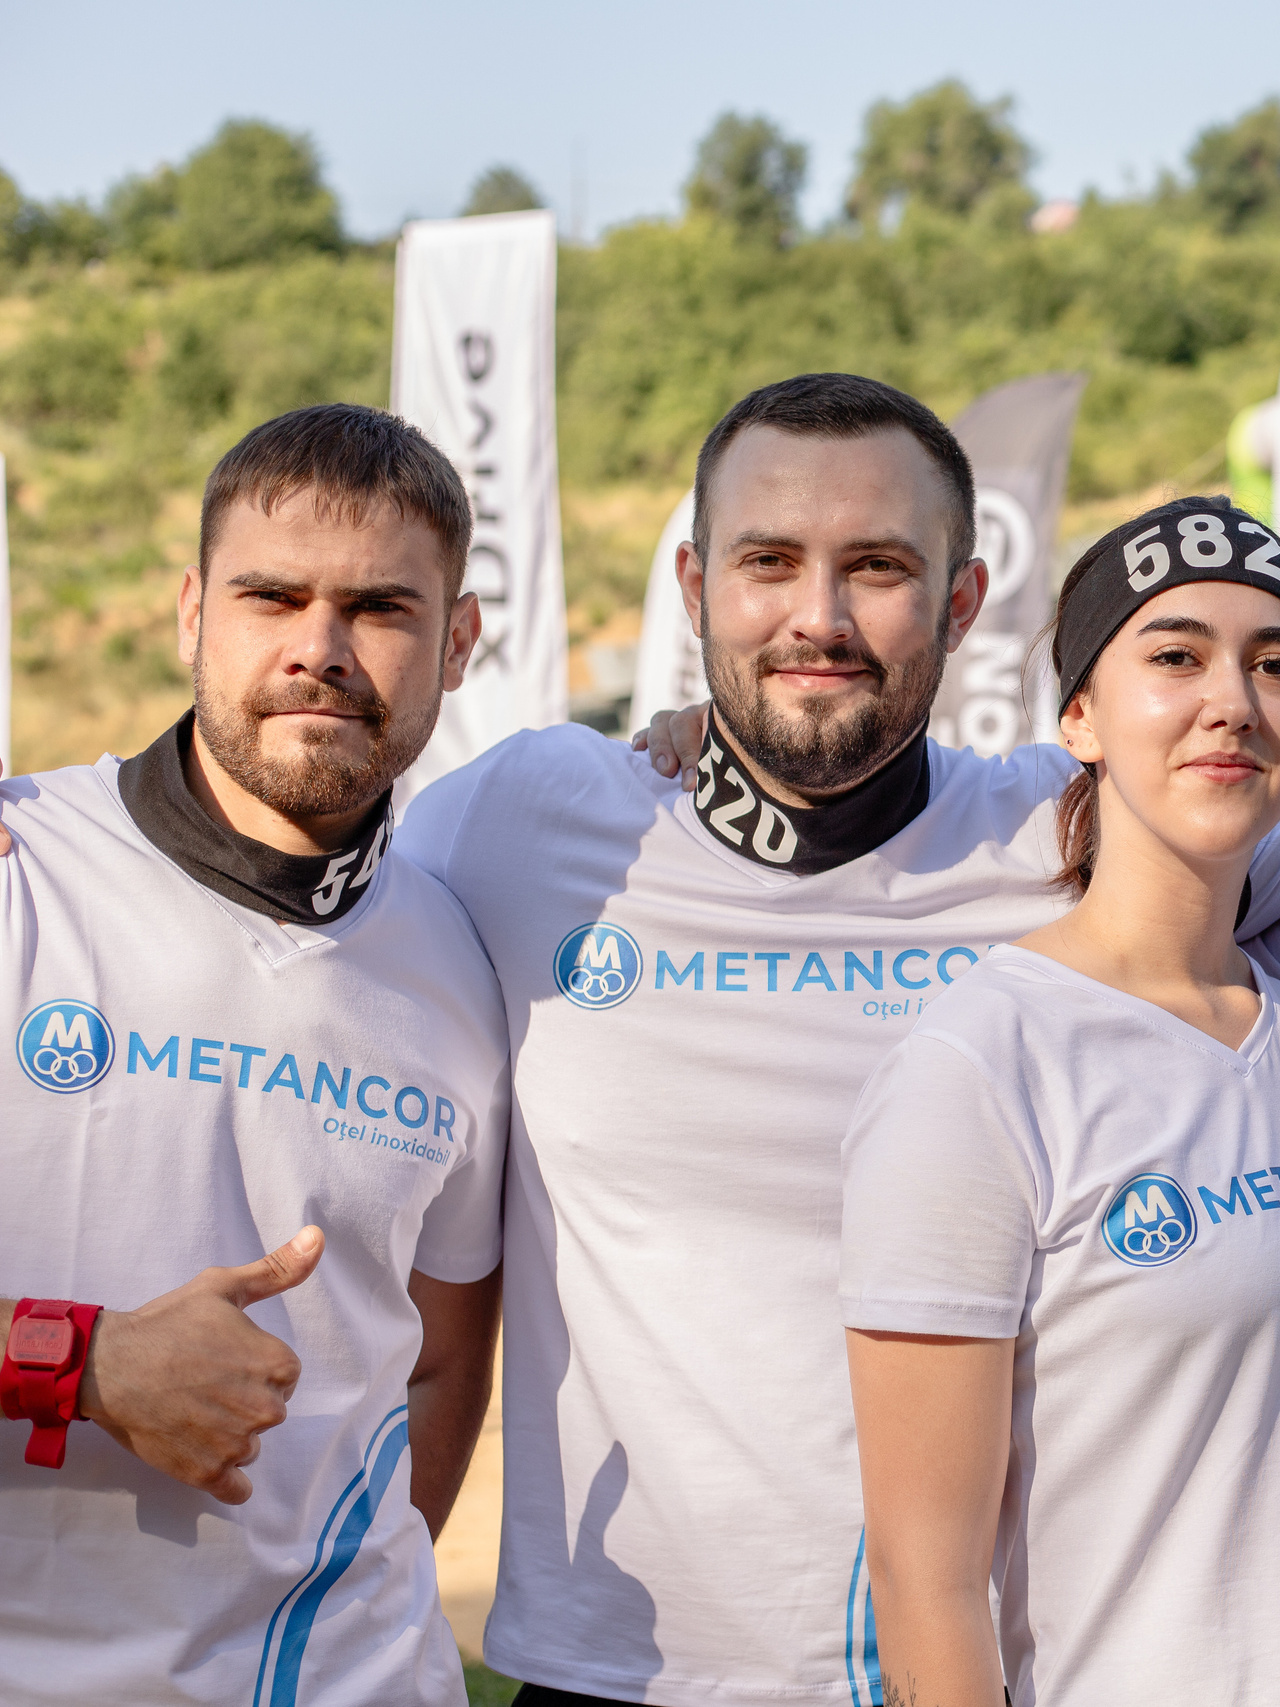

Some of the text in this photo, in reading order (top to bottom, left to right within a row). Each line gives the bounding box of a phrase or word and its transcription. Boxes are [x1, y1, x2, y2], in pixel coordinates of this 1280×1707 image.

[696, 731, 799, 864] 520
[654, 944, 996, 993] METANCO
[126, 1030, 457, 1143] METANCOR
[370, 1127, 451, 1167] inoxidabil
